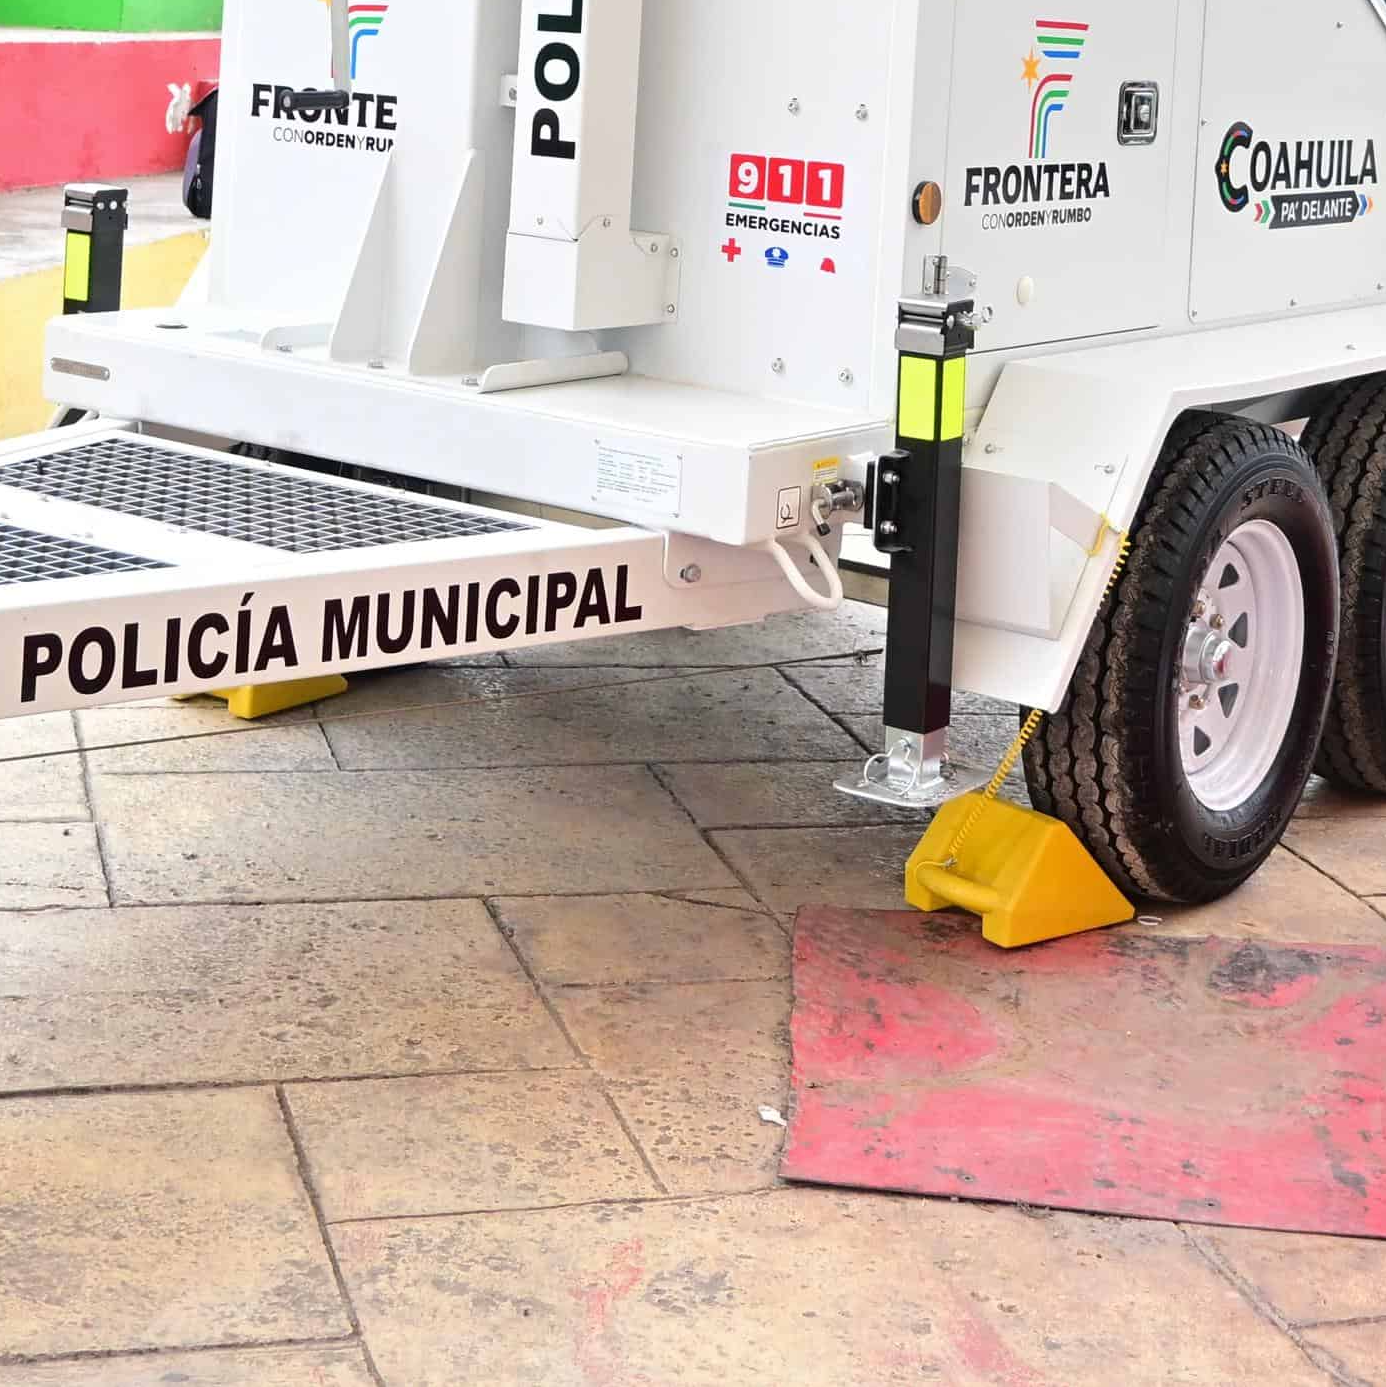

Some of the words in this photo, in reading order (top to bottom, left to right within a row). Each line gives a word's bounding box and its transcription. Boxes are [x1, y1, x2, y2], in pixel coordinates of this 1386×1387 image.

[736, 161, 834, 202] 911
[964, 162, 1110, 207] FRONTERA
[1215, 121, 1378, 213] COAHUILA
[725, 212, 841, 240] EMERGENCIAS
[1301, 197, 1353, 221] DELANTE
[19, 592, 299, 703] POLICÍA
[320, 563, 644, 663] MUNICIPAL
